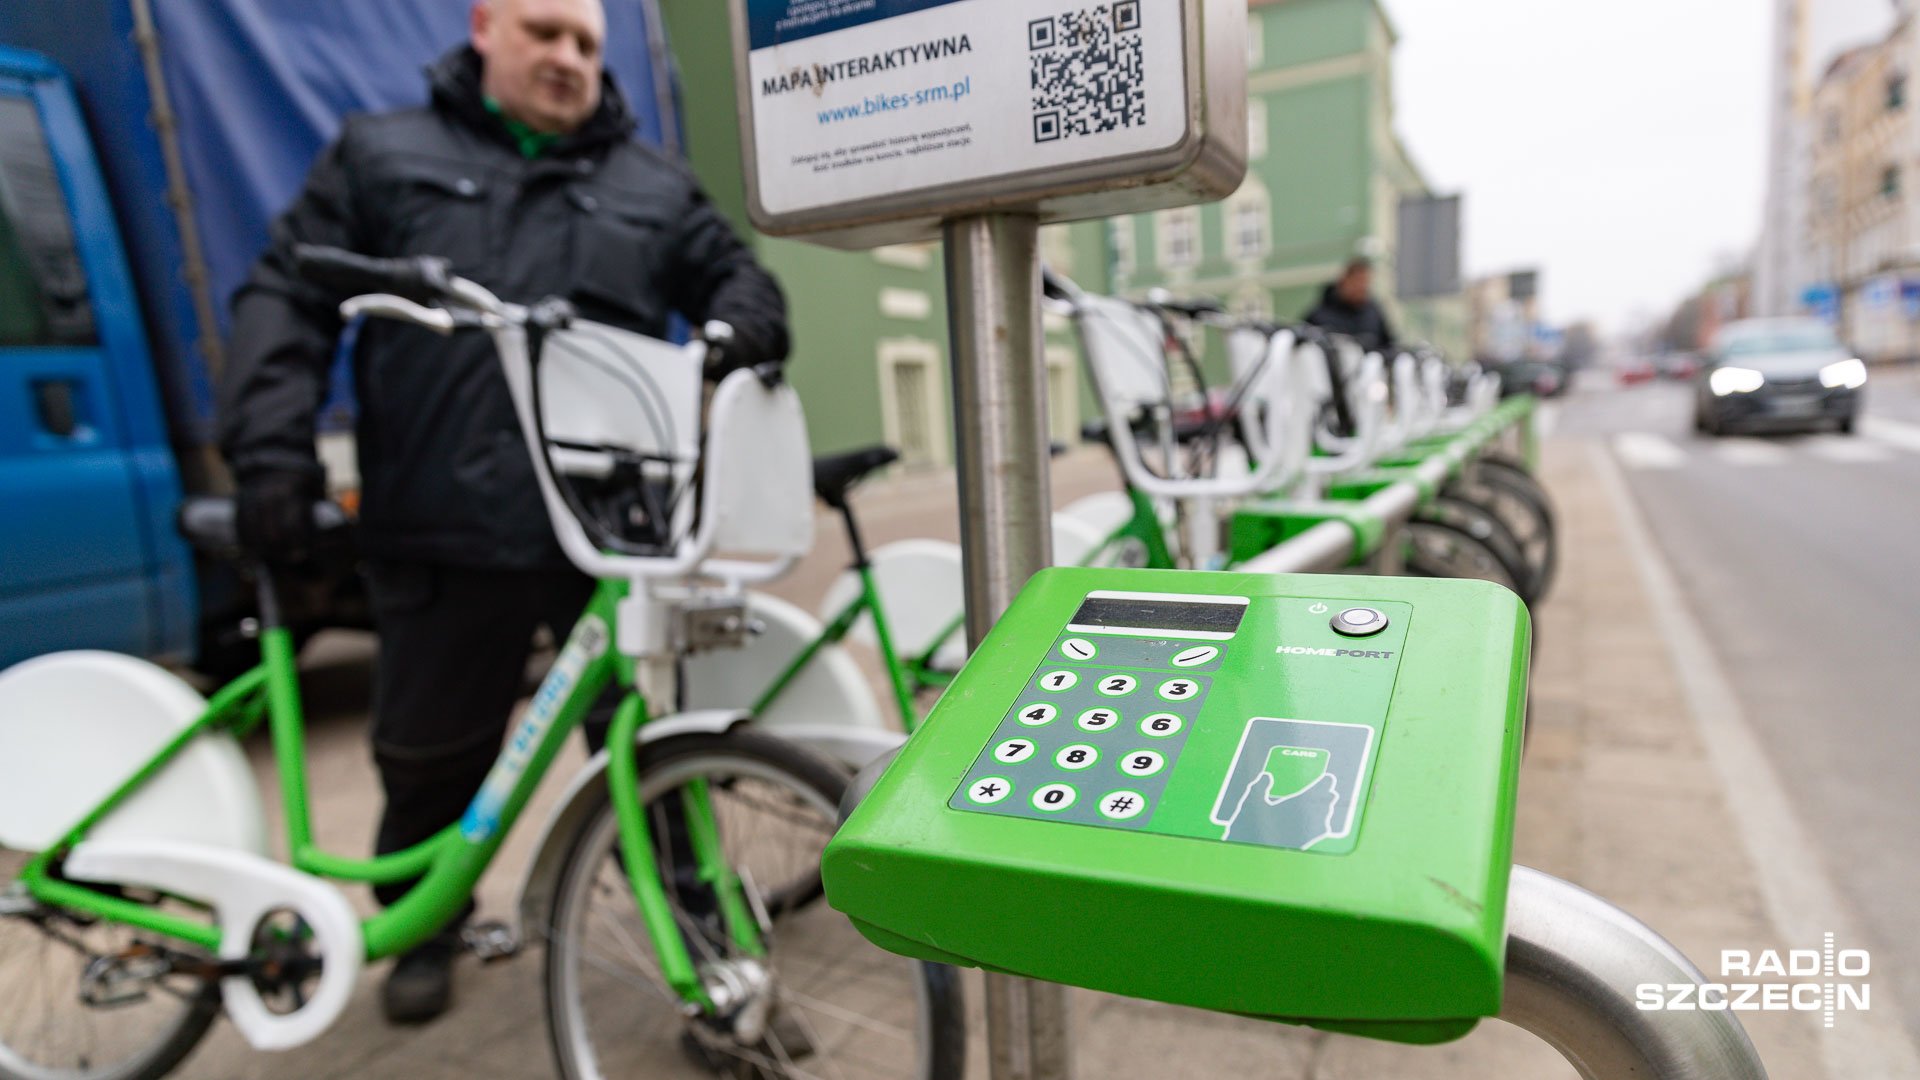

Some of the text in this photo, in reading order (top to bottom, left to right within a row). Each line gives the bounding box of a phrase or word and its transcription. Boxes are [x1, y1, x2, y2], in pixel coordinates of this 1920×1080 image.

[762, 34, 972, 96] MAPA INTERAKTYWNA
[817, 76, 970, 124] www.bikes-srm.pl
[1275, 645, 1394, 659] HOMEPORT
[1054, 675, 1188, 695] 1 2 3
[1026, 708, 1171, 731] 4 5 6
[1005, 744, 1153, 769] 7 8 9
[1282, 749, 1317, 758] CARD
[1044, 790, 1064, 804] 0
